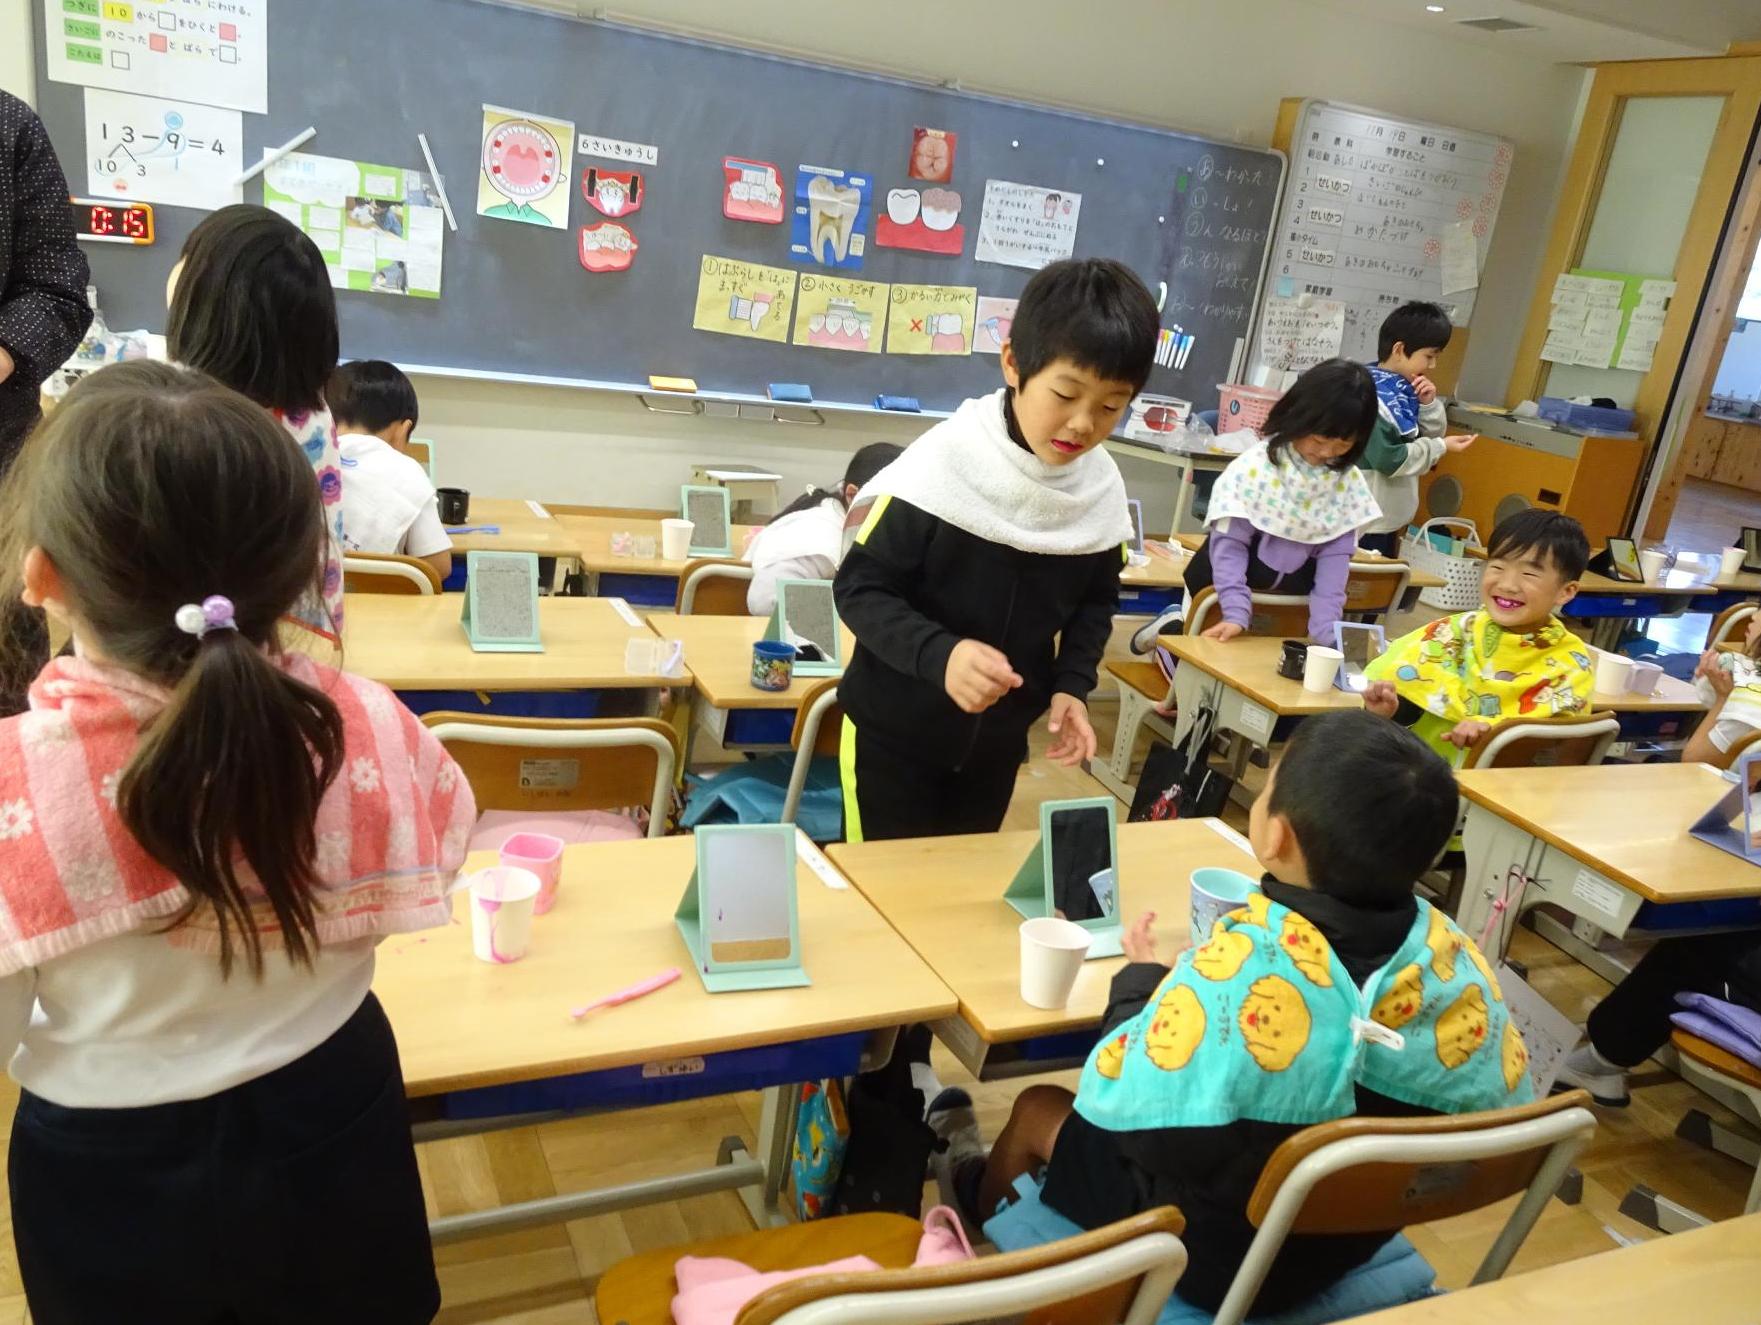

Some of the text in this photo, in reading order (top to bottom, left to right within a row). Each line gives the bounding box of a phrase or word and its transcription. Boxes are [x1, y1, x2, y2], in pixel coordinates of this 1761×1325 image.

[582, 139, 654, 160] 6さいきゅうし
[137, 165, 147, 177] 3
[1300, 183, 1308, 192] 2
[1318, 178, 1351, 192] せいかつ
[1297, 200, 1304, 209] 3
[1310, 210, 1342, 223] せいかつ
[91, 206, 144, 236] 0:15
[1293, 216, 1301, 225] 4
[1286, 250, 1293, 259] 5
[1302, 251, 1334, 264] せいかつ
[1283, 264, 1289, 274] 6
